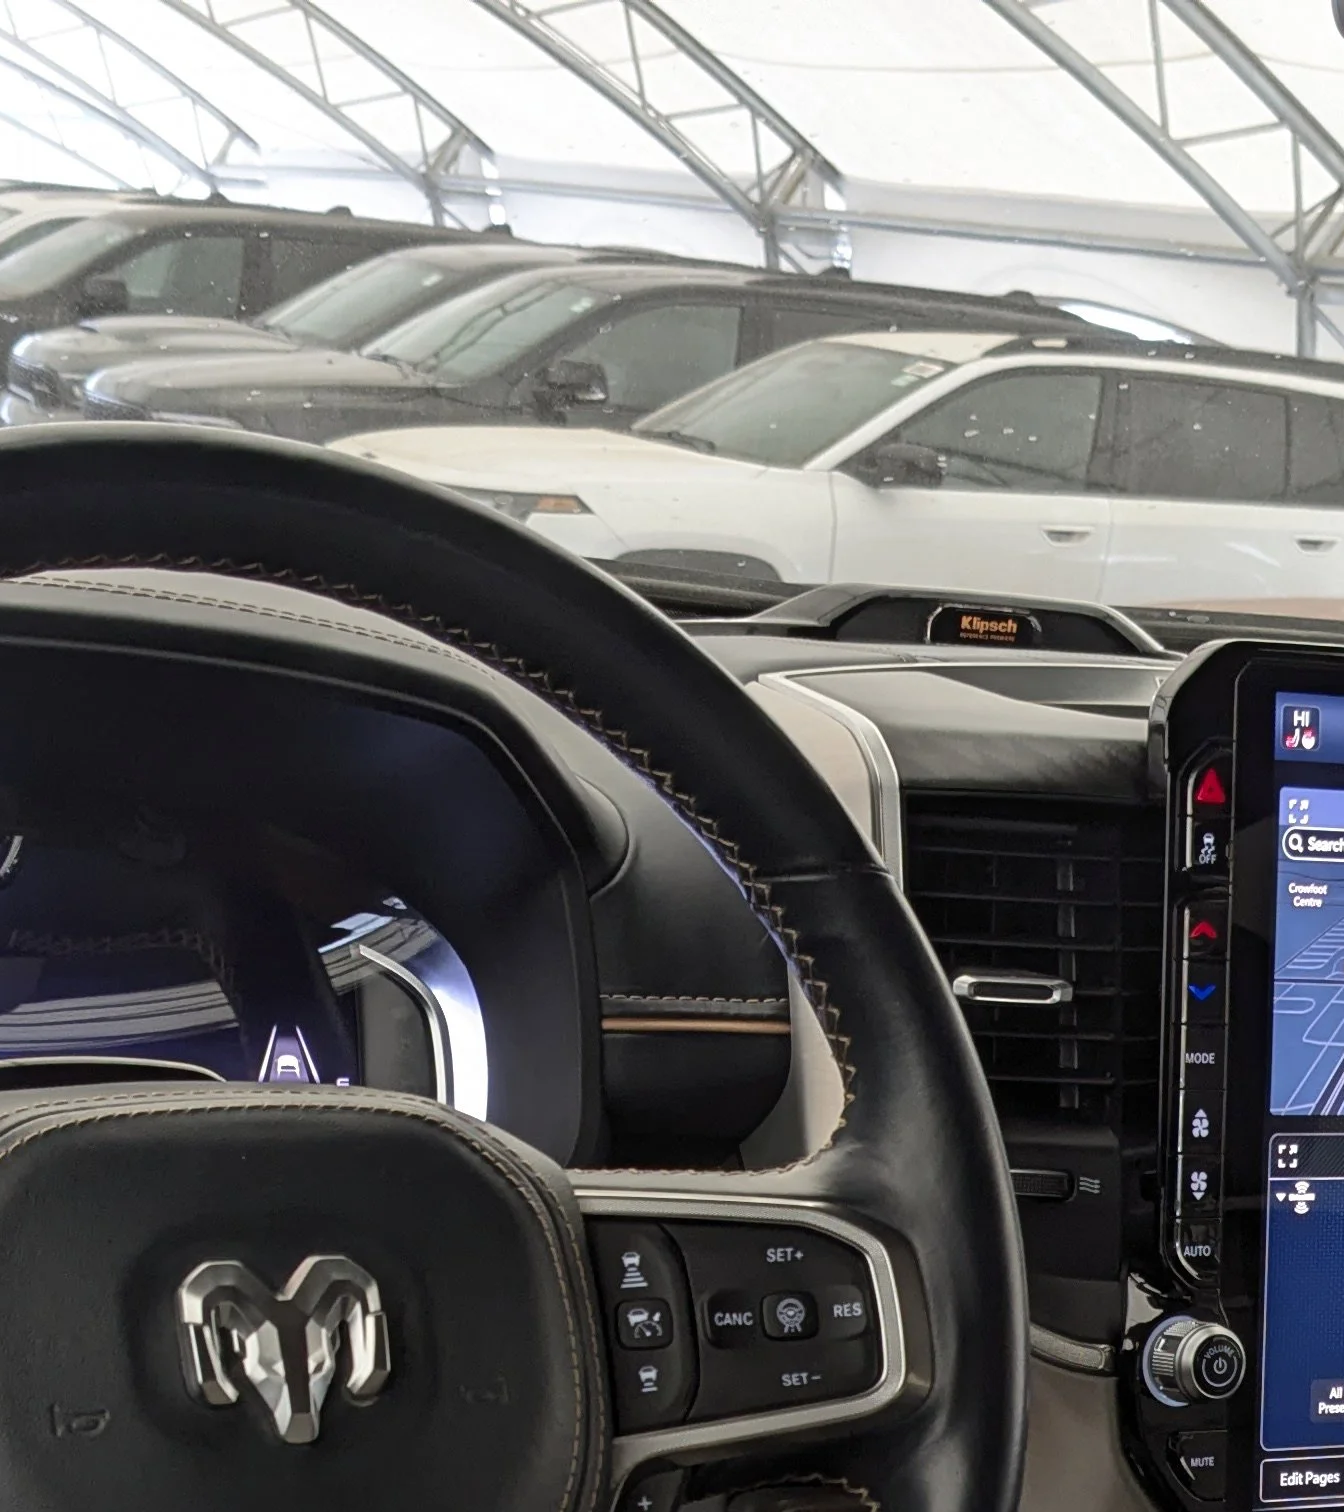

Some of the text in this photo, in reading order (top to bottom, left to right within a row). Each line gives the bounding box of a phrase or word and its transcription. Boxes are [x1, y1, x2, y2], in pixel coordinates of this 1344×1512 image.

[960, 615, 1018, 633] Klipsch
[1293, 710, 1310, 727] HI
[1199, 854, 1217, 865] OFF
[1288, 883, 1327, 895] Crowfoot
[1293, 896, 1322, 908] Centre
[1185, 1052, 1216, 1064] MODE
[1183, 1245, 1212, 1257] AUTO
[833, 1303, 863, 1318] RES
[714, 1311, 754, 1326] CANC
[1203, 1344, 1235, 1359] VOLUME
[1329, 1387, 1343, 1399] All
[1190, 1456, 1215, 1467] MUTE
[1280, 1471, 1340, 1487] Edit Pages
